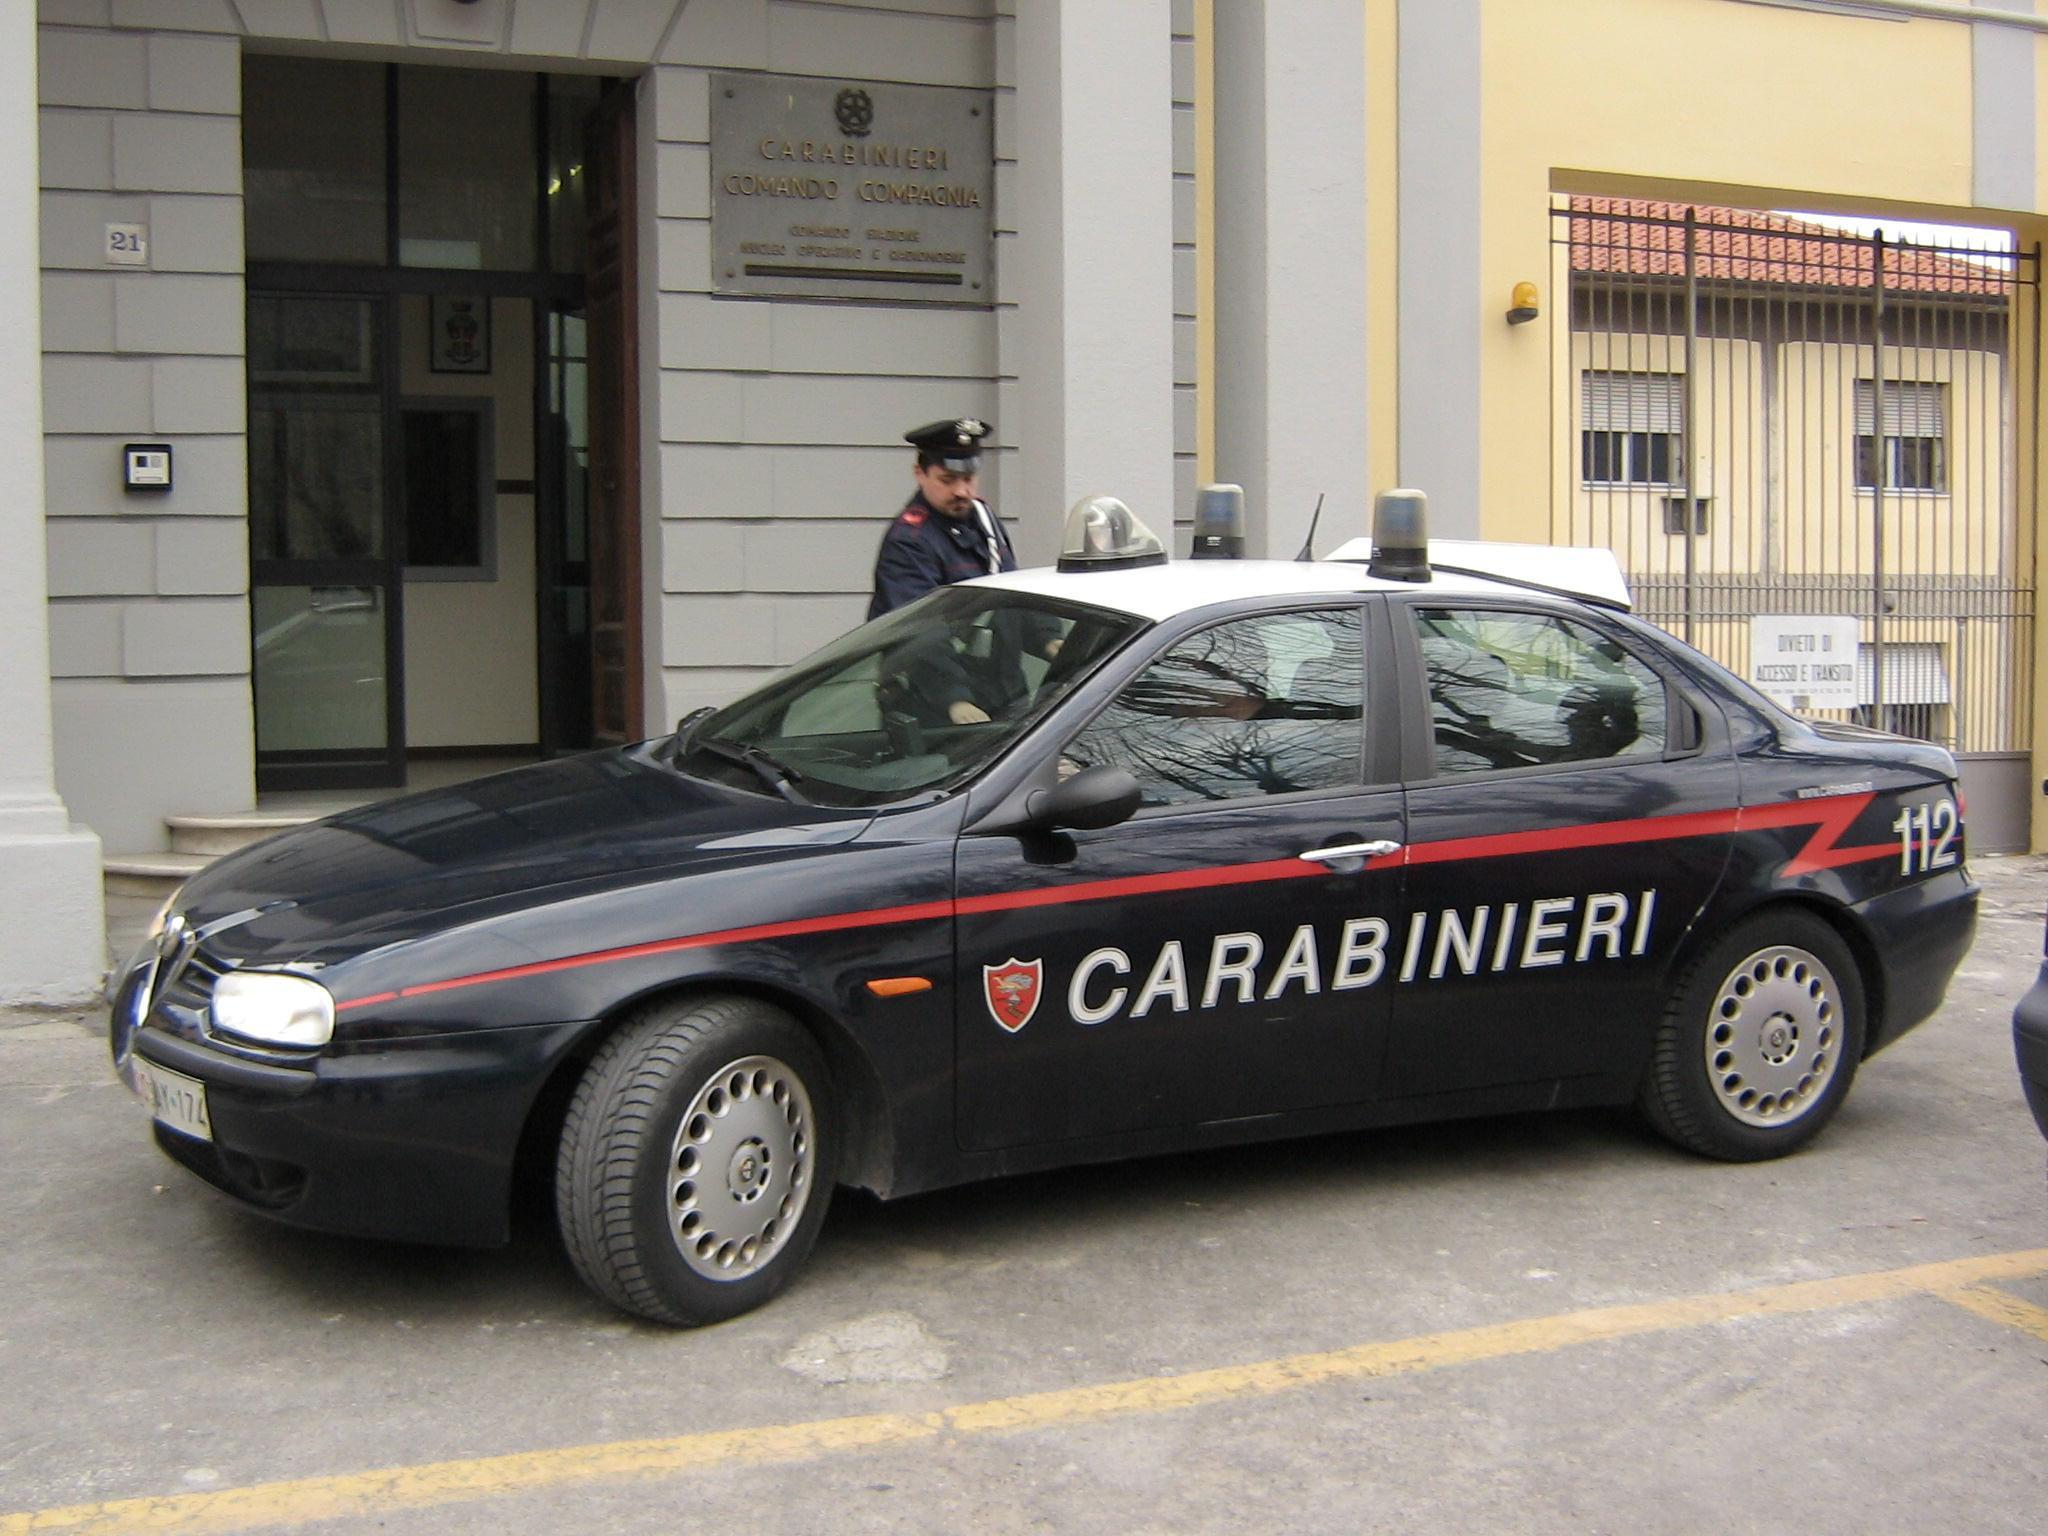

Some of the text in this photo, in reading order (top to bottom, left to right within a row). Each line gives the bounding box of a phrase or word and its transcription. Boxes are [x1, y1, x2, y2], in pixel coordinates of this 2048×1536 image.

[759, 138, 949, 171] CARABINIERI
[723, 173, 983, 209] COMANDO COMPAGNIA
[110, 231, 141, 252] 21
[1800, 664, 1808, 682] E
[1893, 798, 1957, 878] 112
[1067, 888, 1656, 1025] CARABINIERI
